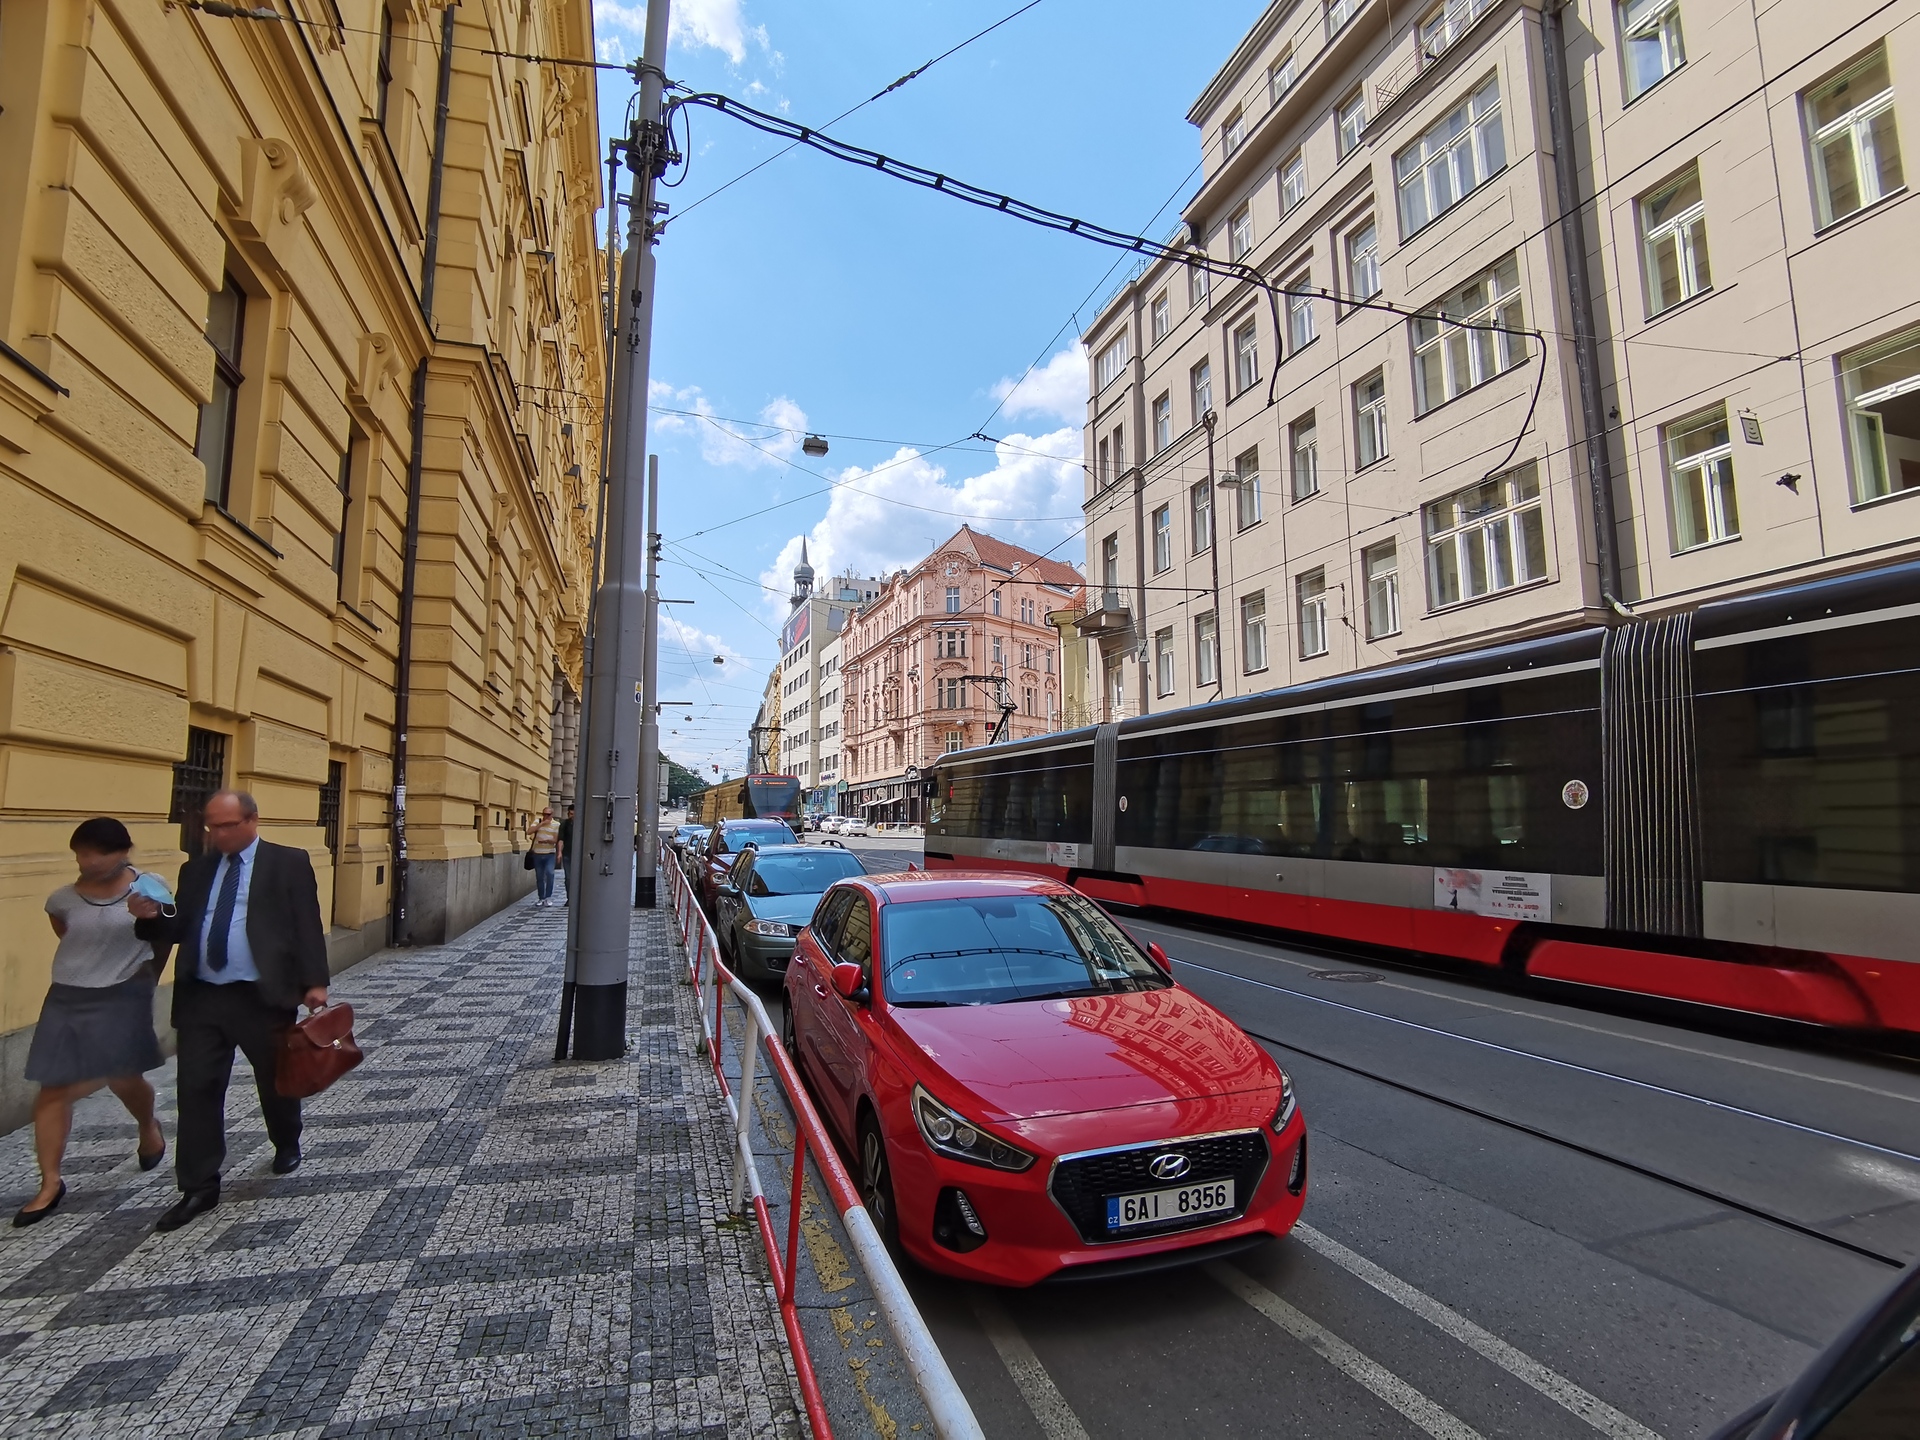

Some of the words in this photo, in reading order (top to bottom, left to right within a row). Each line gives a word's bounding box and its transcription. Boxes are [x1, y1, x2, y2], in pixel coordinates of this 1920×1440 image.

[1124, 1195, 1158, 1221] 6AI
[1178, 1185, 1226, 1213] 8356
[1108, 1216, 1119, 1224] CZ
